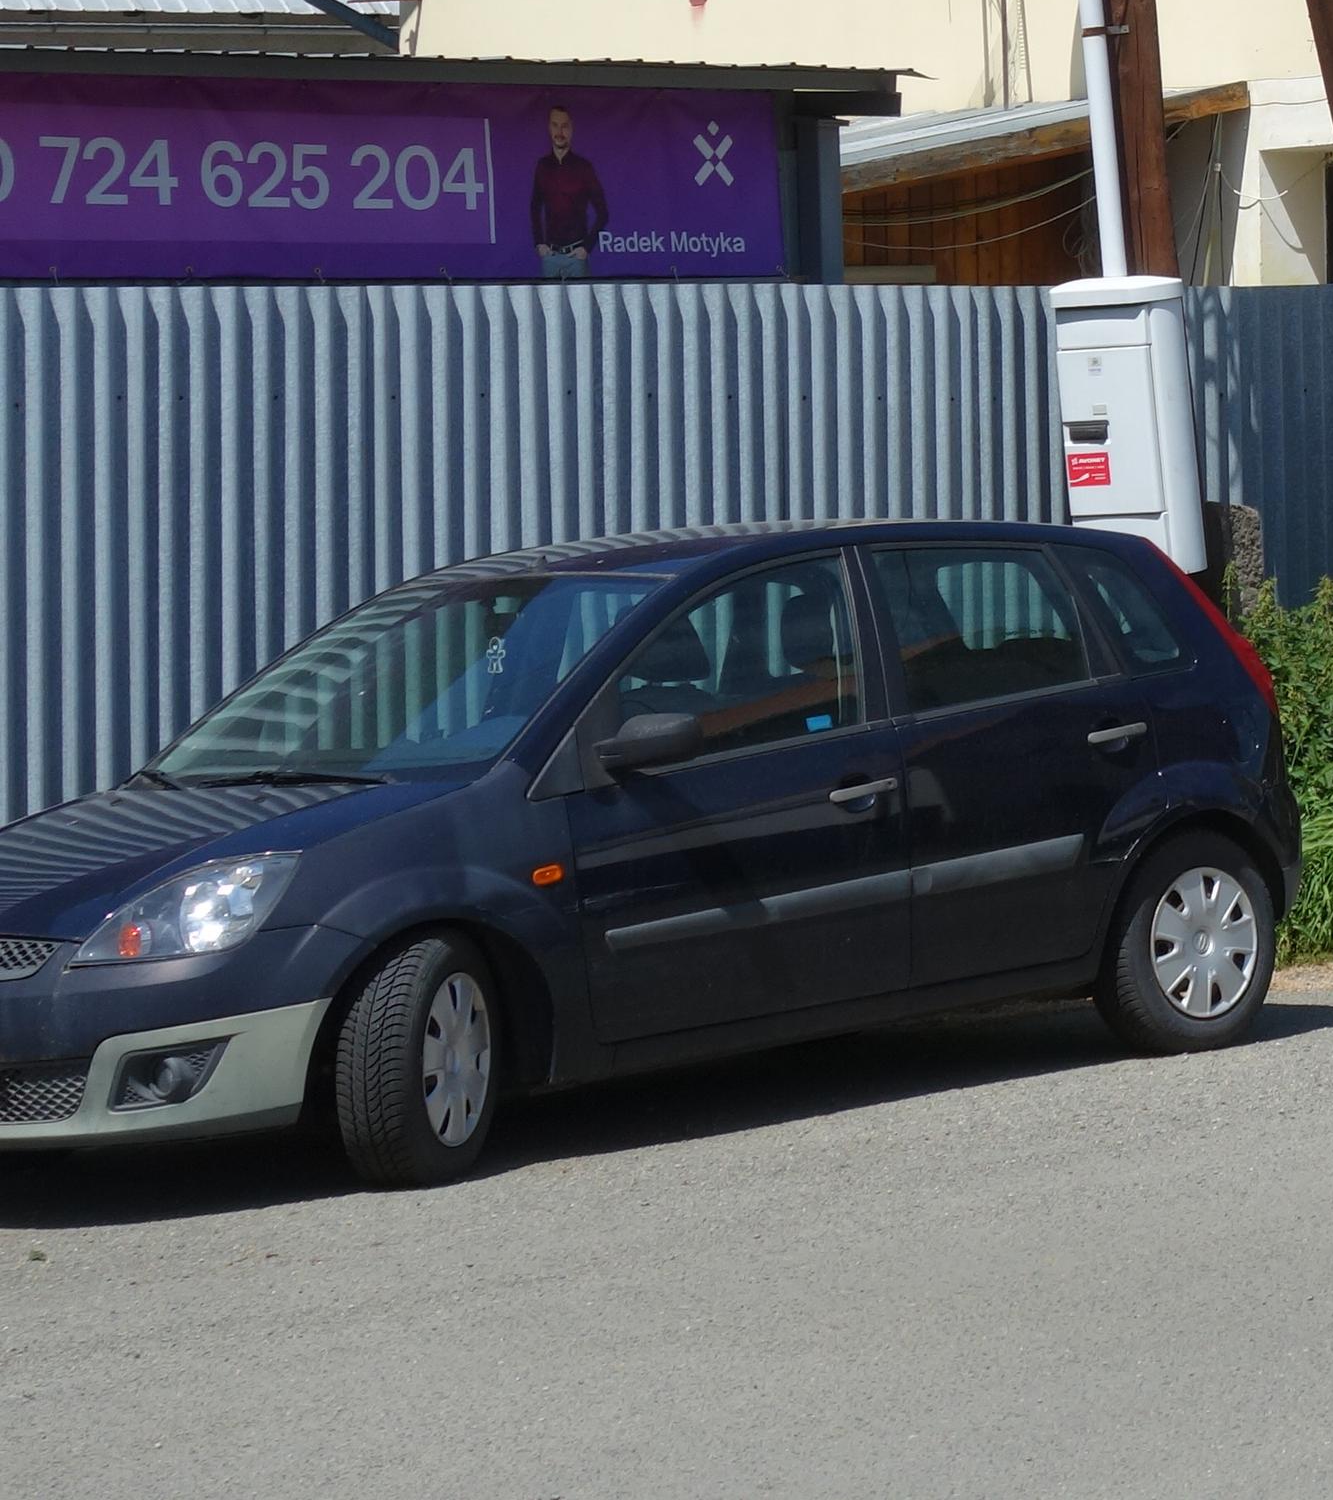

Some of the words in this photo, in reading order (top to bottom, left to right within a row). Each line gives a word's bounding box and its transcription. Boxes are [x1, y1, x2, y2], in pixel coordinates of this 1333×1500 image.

[38, 135, 179, 206] 724
[200, 140, 330, 210] 625
[350, 144, 485, 211] 204
[598, 231, 665, 253] Radek
[670, 231, 746, 258] Motyka
